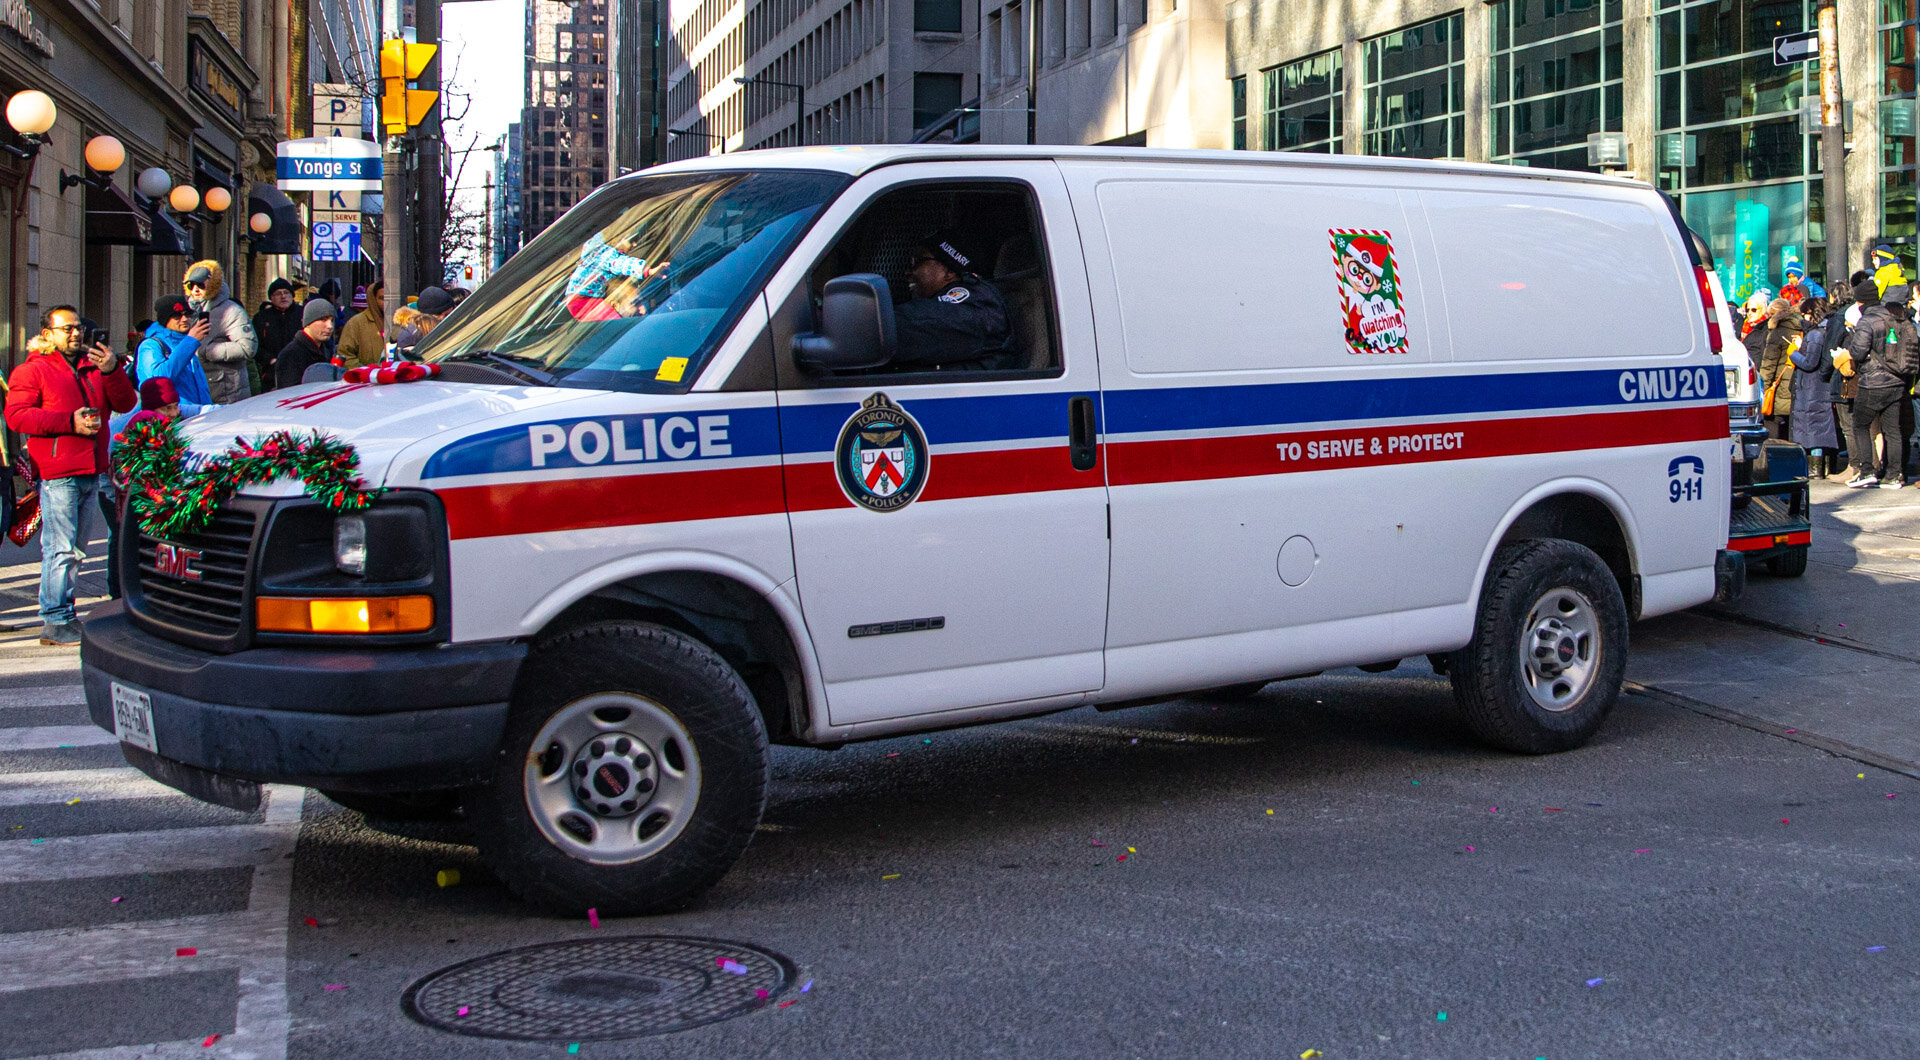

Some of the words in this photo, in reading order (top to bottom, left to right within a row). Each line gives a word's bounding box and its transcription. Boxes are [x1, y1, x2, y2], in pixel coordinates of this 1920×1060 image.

[294, 159, 343, 178] Yonge
[349, 162, 362, 175] St
[940, 241, 970, 266] AUXILIARY
[1371, 301, 1386, 316] I'M
[1376, 330, 1397, 347] YOU
[1618, 367, 1709, 401] CMU20
[855, 411, 905, 427] TORONTO
[528, 414, 732, 467] POLICE
[1276, 442, 1302, 461] TO
[1307, 438, 1365, 459] SERVE
[1370, 437, 1383, 455] &
[1387, 432, 1464, 454] PROTECT
[868, 496, 904, 508] POLICE
[155, 543, 203, 580] GMC
